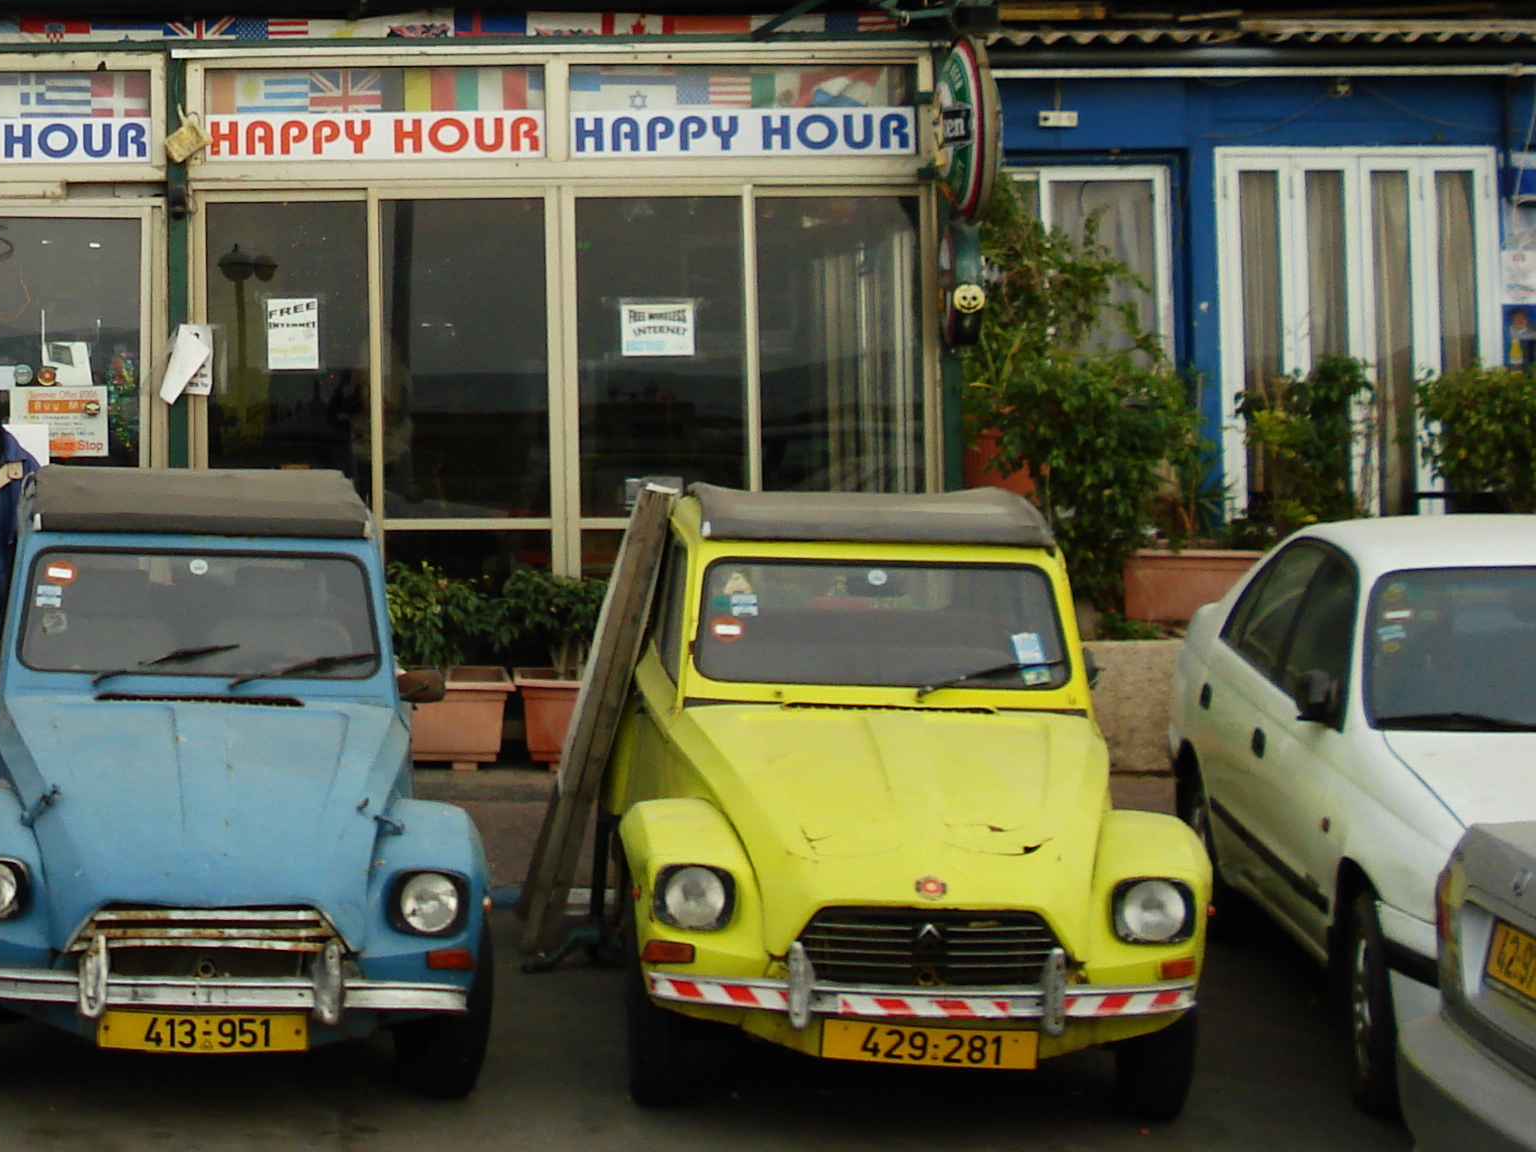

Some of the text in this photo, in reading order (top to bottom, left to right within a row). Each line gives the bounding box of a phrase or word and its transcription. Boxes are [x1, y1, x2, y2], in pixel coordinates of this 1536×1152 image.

[4, 122, 147, 158] HOUR
[210, 117, 540, 156] HAPPY HOUR
[575, 113, 910, 152] HAPPY HOUR
[268, 301, 316, 319] FREE
[628, 309, 687, 324] FREE WIRELESS
[268, 321, 316, 329] INTERNET
[632, 325, 687, 337] INTERNET
[34, 401, 59, 412] Buy
[78, 439, 104, 452] Stop
